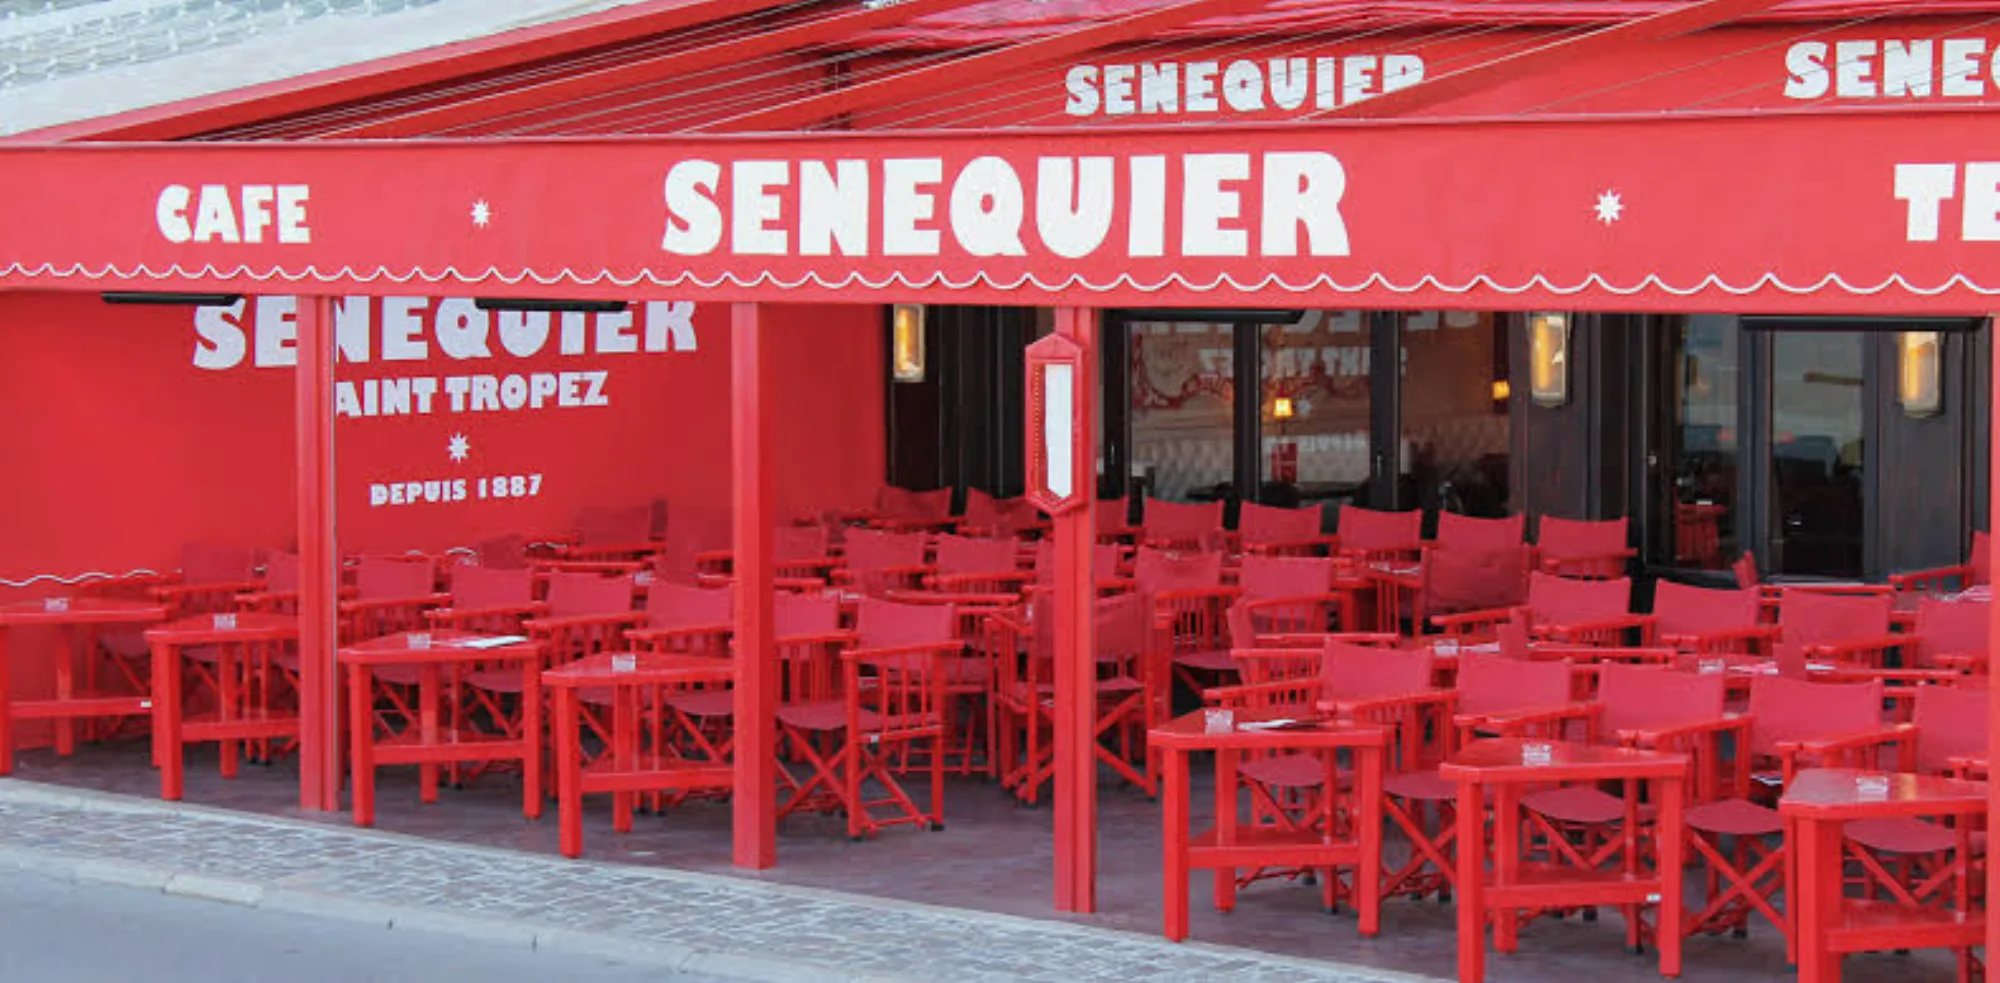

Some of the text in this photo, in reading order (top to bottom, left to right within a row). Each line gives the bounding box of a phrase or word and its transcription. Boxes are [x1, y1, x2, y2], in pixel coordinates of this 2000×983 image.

[1783, 38, 2000, 99] SENE
[155, 183, 311, 245] CAFE
[661, 151, 1351, 259] SENEQUIER
[335, 370, 609, 417] AINT TROPEZ
[370, 474, 543, 507] DEPUIS 1887
